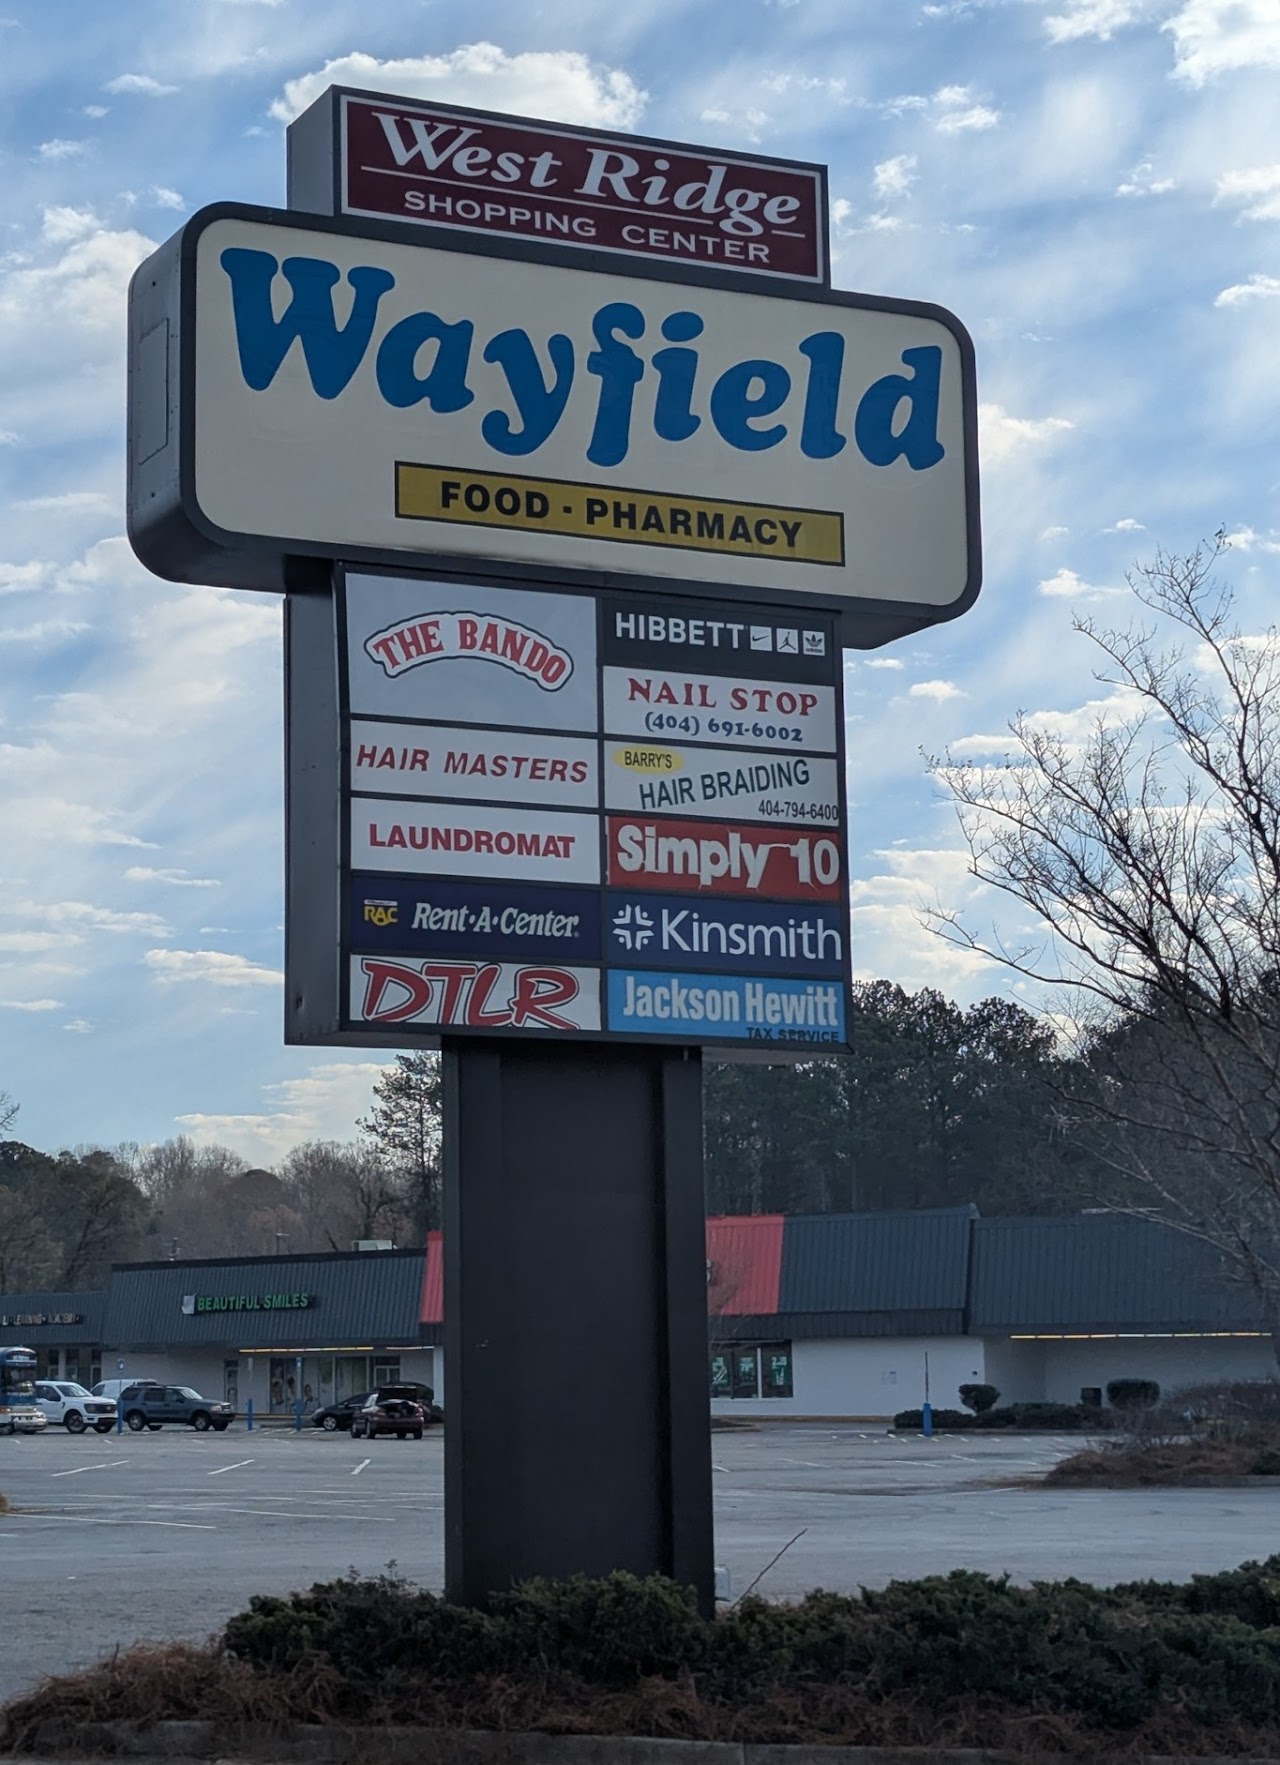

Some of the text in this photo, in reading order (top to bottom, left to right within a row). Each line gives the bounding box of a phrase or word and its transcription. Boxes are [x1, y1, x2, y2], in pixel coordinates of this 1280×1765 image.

[371, 110, 801, 237] West Ridge
[403, 190, 771, 264] SHOPPING CENTER
[220, 247, 945, 471] Wayfield
[441, 480, 550, 520] FOOD
[585, 498, 803, 549] PHARMACY
[372, 619, 567, 684] THE BANDO
[615, 611, 745, 650] HIBBETT
[628, 677, 818, 717] NAIL STOP
[645, 711, 804, 743] (404) 691-6002
[356, 744, 588, 784] HAIR MASTERS
[624, 751, 673, 769] BARRY'S
[639, 759, 810, 810] HAIR BRAIDING
[758, 799, 839, 821] 404-794-6400
[369, 823, 576, 859] LAUNDROMAT
[616, 824, 840, 889] Simply 10
[364, 905, 398, 926] RAC
[661, 908, 842, 961] Kinsmith
[361, 957, 581, 1031] DTLR
[623, 975, 839, 1027] Jackson Hewitt
[746, 1027, 839, 1043] TAX SERVICE
[197, 1293, 309, 1311] BEAUTIFUL SMILES
